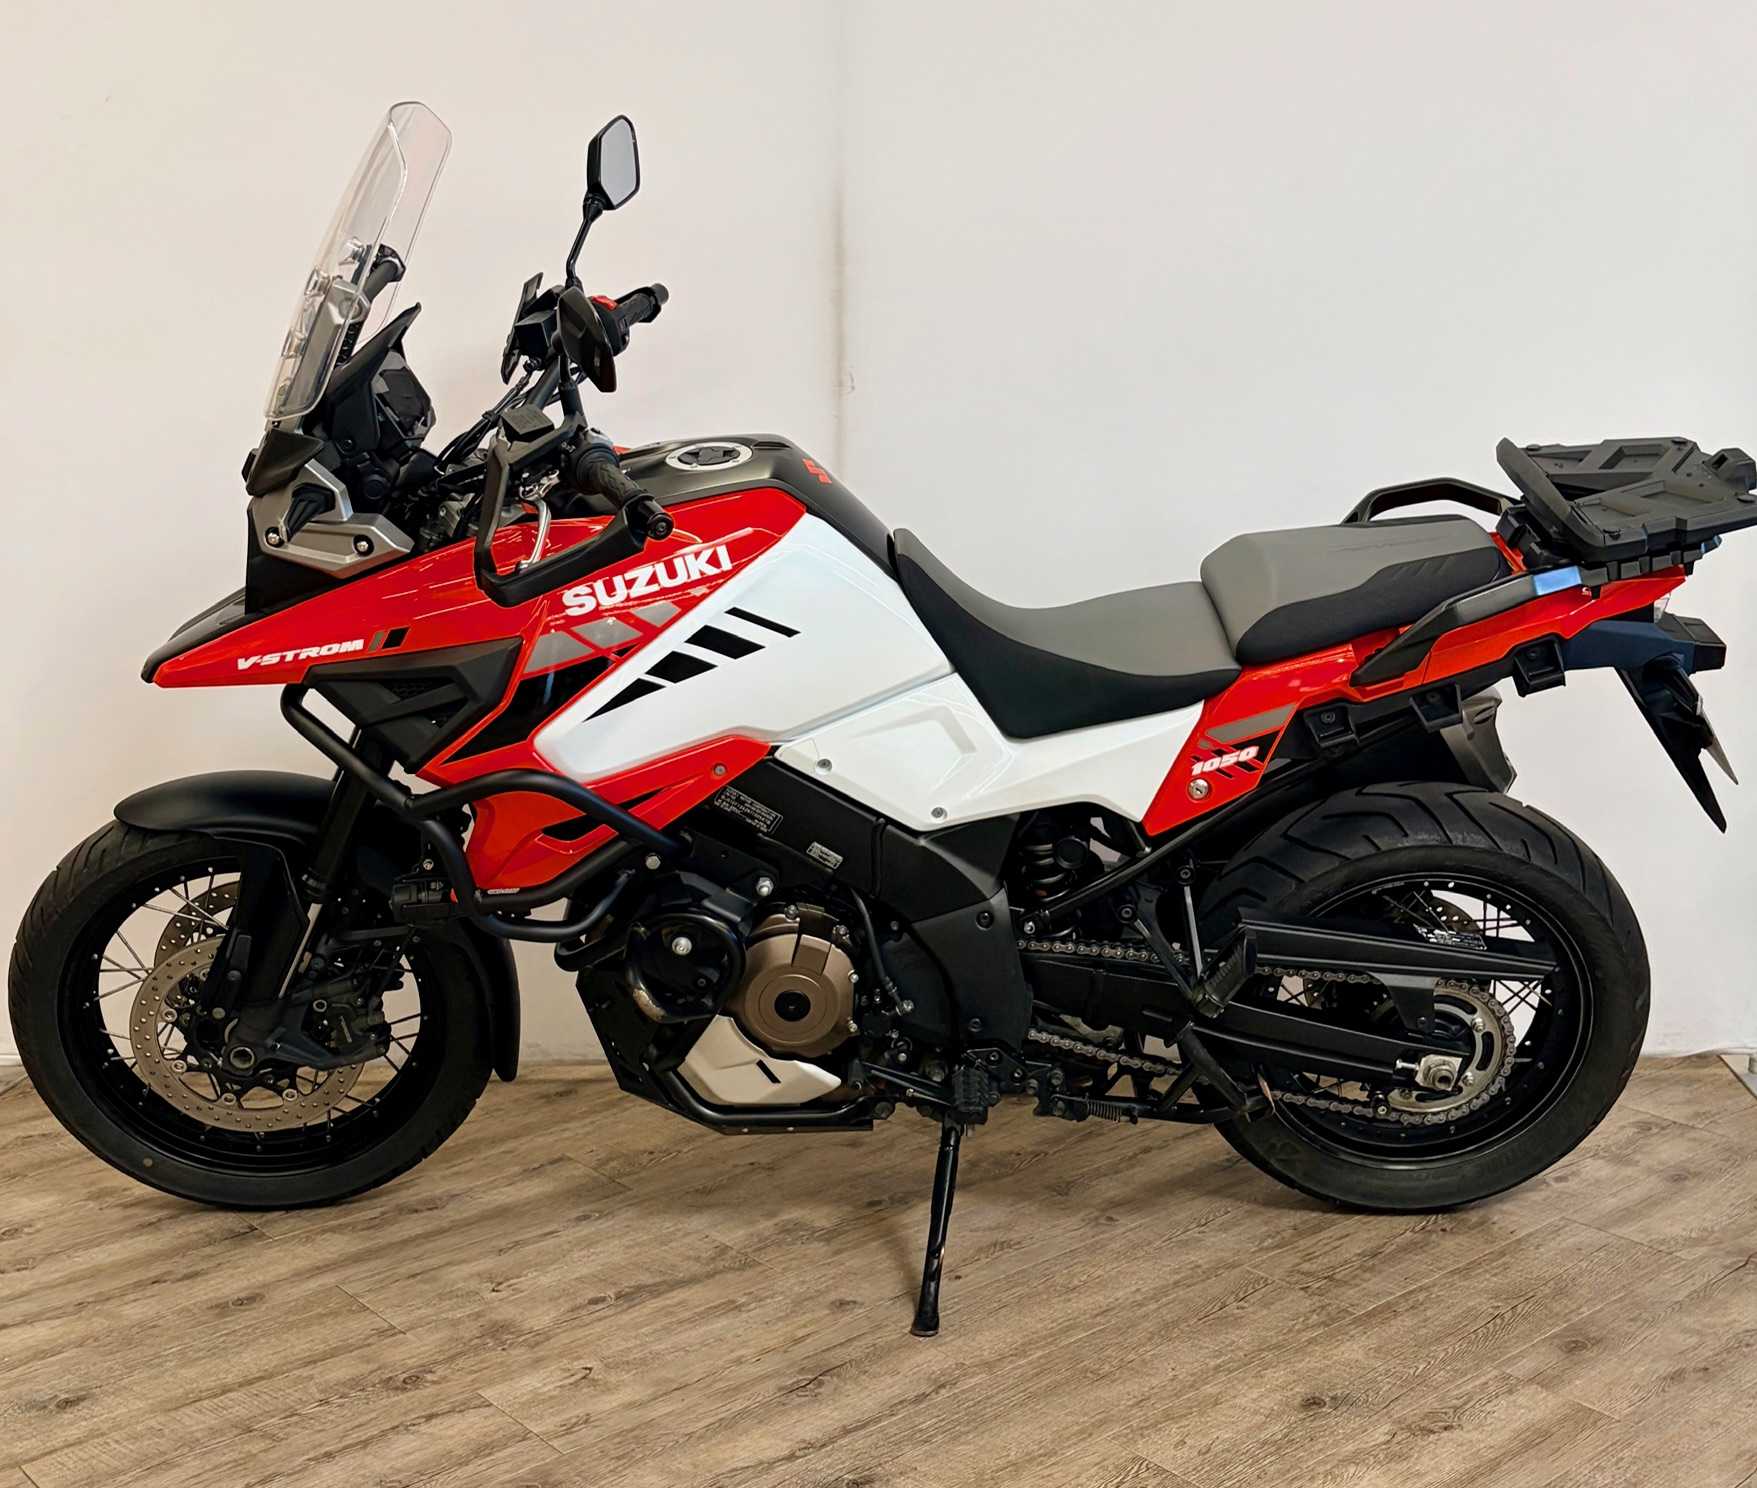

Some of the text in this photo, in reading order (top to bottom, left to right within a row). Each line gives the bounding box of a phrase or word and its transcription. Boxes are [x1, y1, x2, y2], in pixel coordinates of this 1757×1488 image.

[562, 544, 732, 616] SUZUKI
[237, 639, 364, 670] V-STROM
[1191, 745, 1259, 776] 1050
